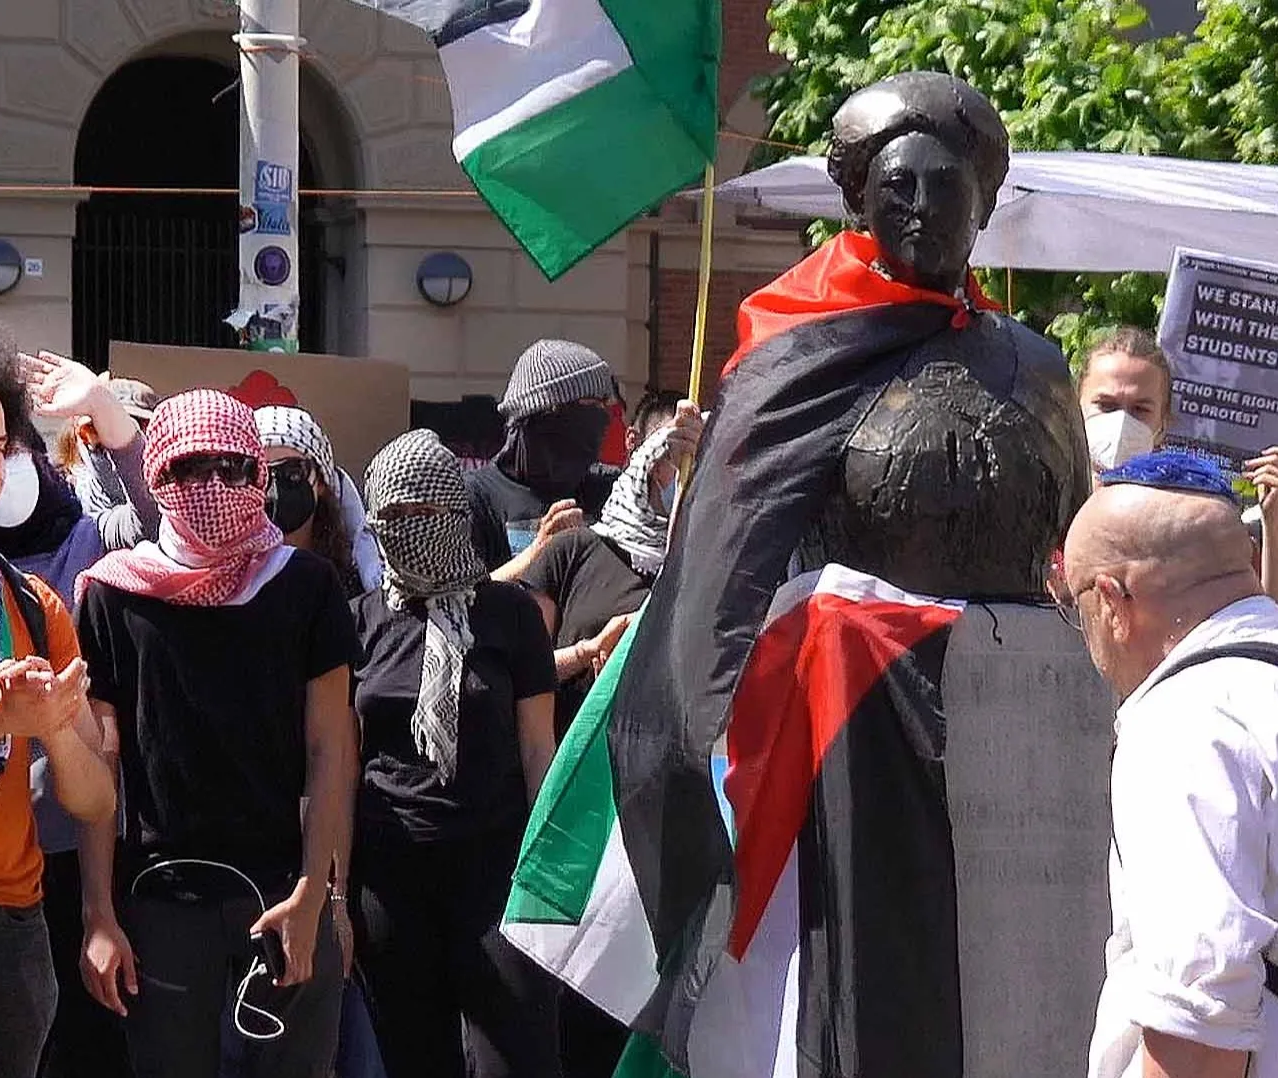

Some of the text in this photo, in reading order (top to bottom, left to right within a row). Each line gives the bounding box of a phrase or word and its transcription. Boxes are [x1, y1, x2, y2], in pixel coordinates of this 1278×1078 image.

[1197, 285, 1224, 302] WE
[1195, 310, 1243, 334] WITH
[1186, 335, 1278, 365] STUDENTS
[1172, 379, 1212, 398] EFEND
[1217, 389, 1239, 402] THE
[1181, 400, 1259, 425] TO PROTEST
